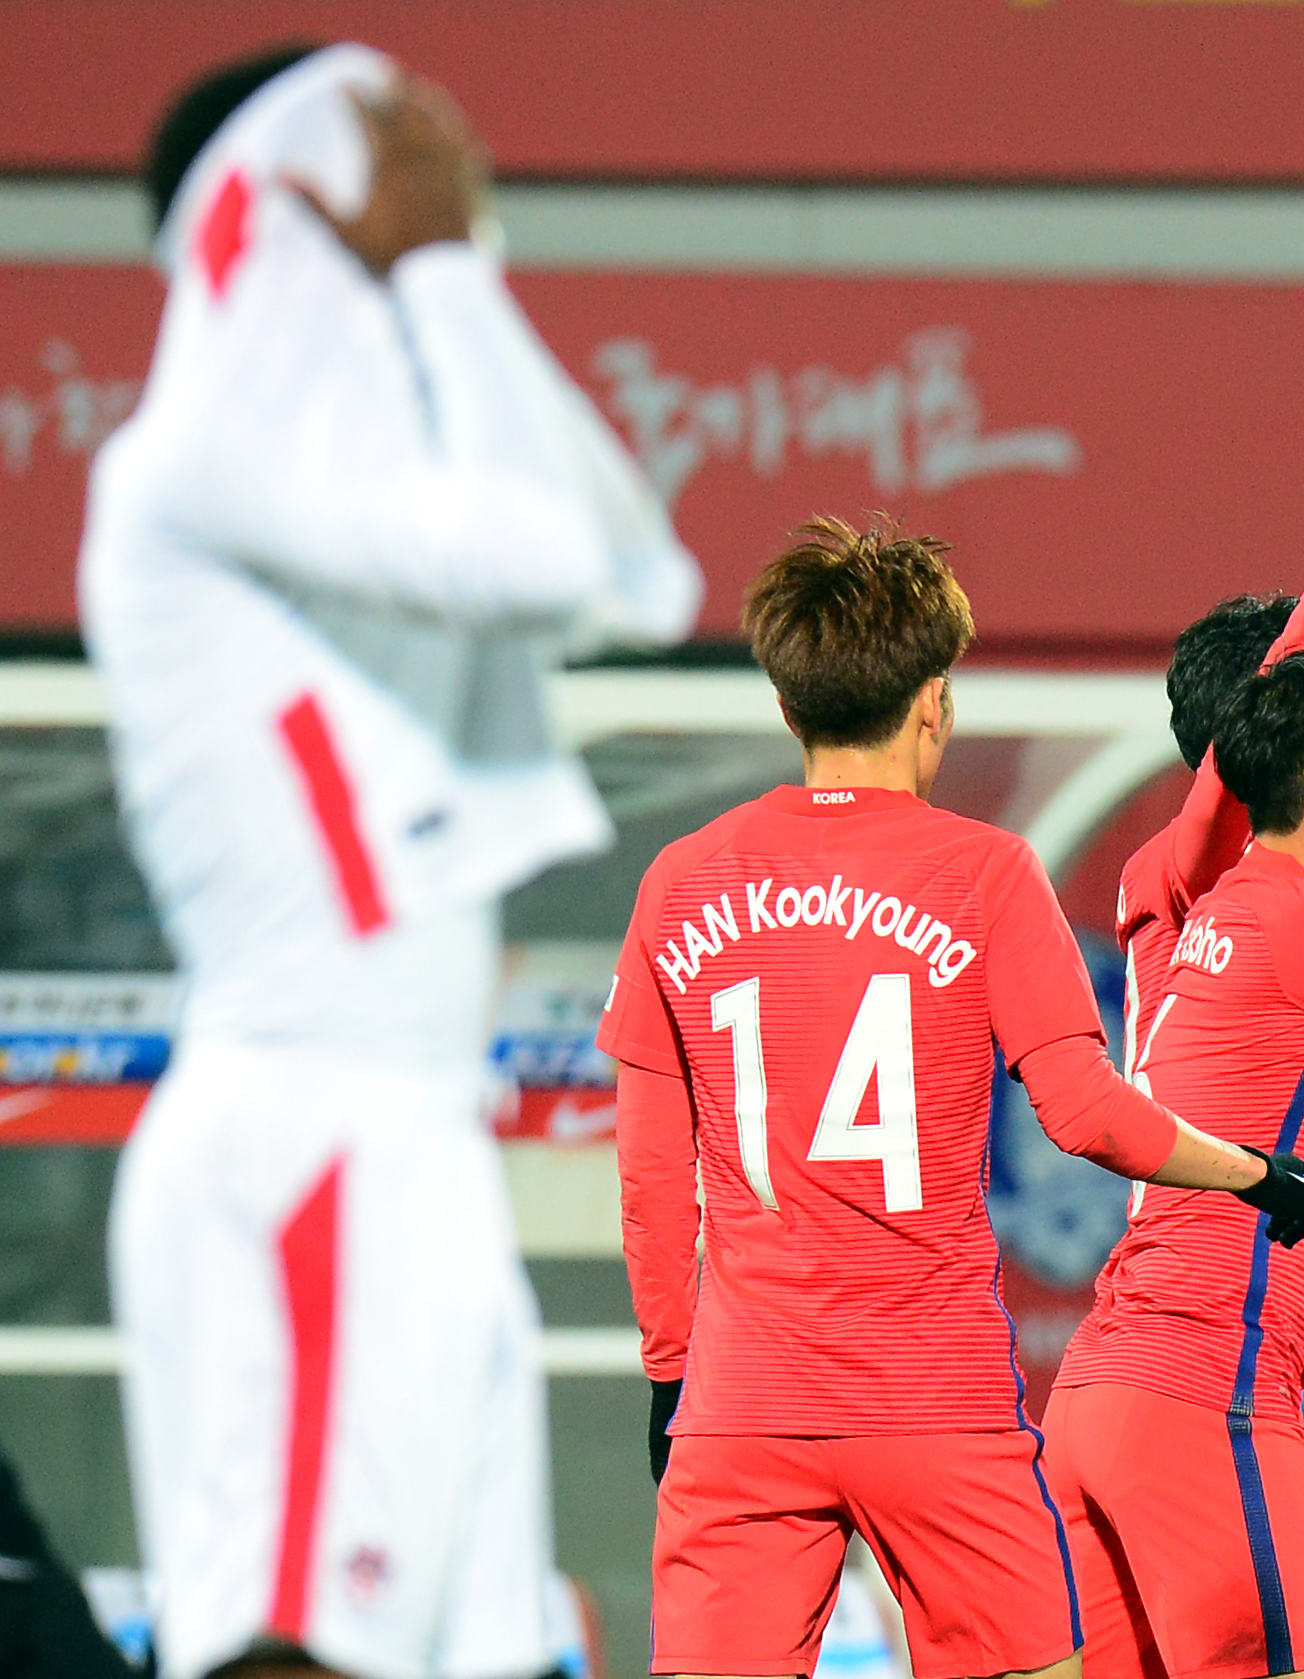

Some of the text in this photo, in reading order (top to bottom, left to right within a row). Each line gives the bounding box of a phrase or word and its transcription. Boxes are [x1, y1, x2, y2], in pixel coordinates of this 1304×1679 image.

[812, 791, 856, 805] KOREA
[656, 875, 977, 994] HAN Kookyoung
[710, 973, 923, 1213] 14
